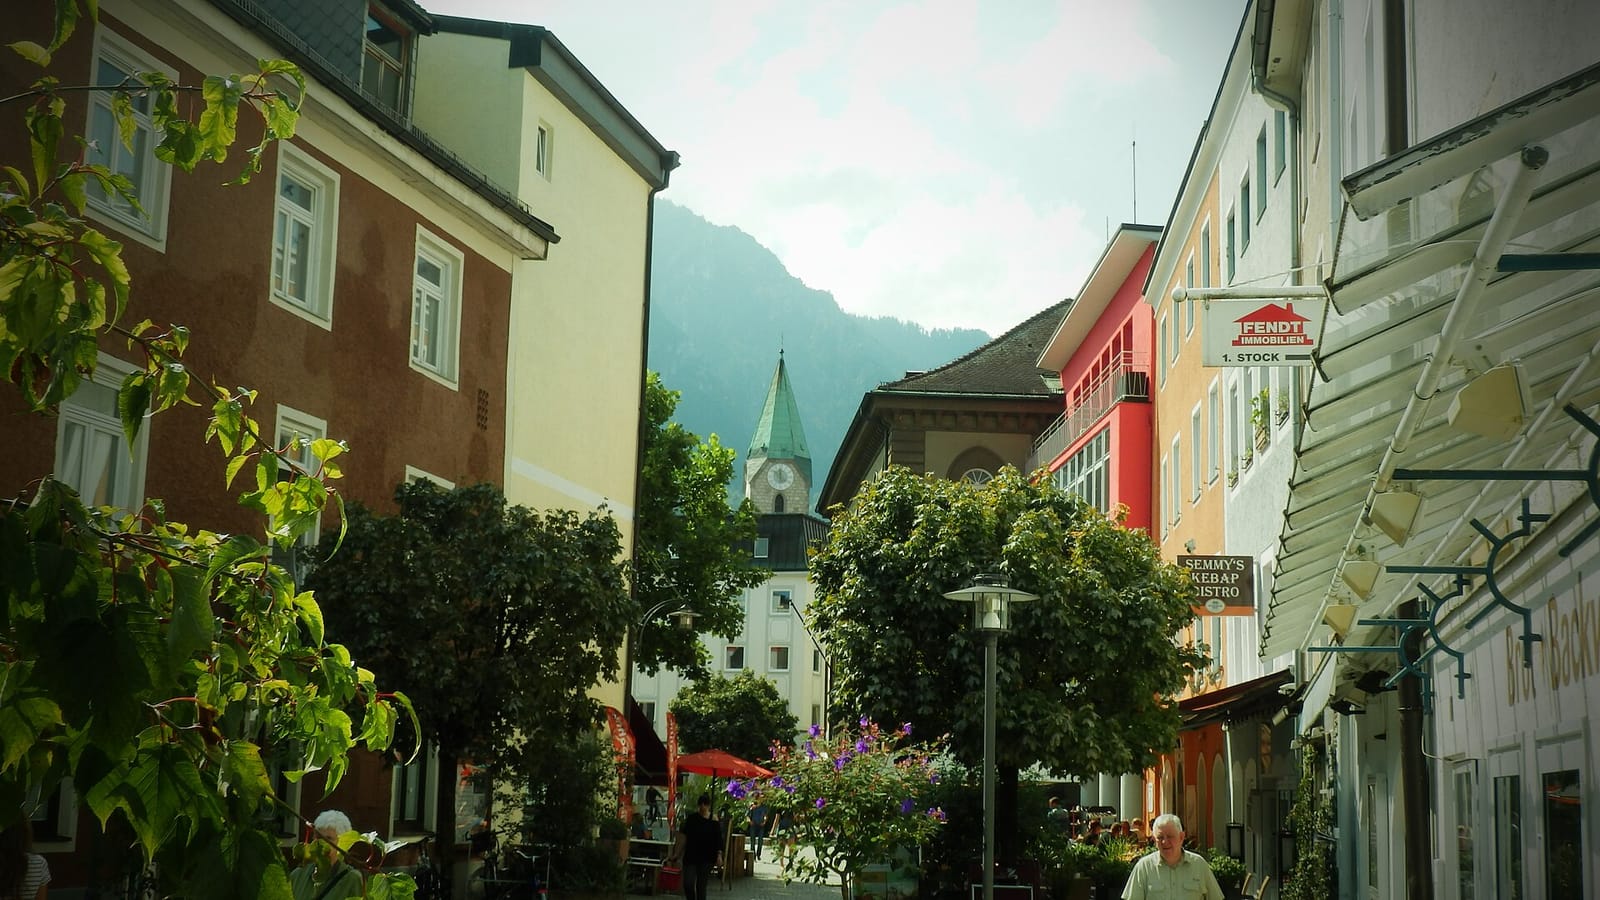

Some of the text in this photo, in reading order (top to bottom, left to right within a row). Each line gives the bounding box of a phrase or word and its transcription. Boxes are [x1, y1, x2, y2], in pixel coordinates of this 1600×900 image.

[1243, 321, 1302, 333] FENDT
[1241, 336, 1304, 345] IMMOBILIEN
[1222, 353, 1280, 362] 1. STOCK
[1185, 558, 1245, 571] SEMMY'S
[1192, 572, 1239, 584] KEBAP
